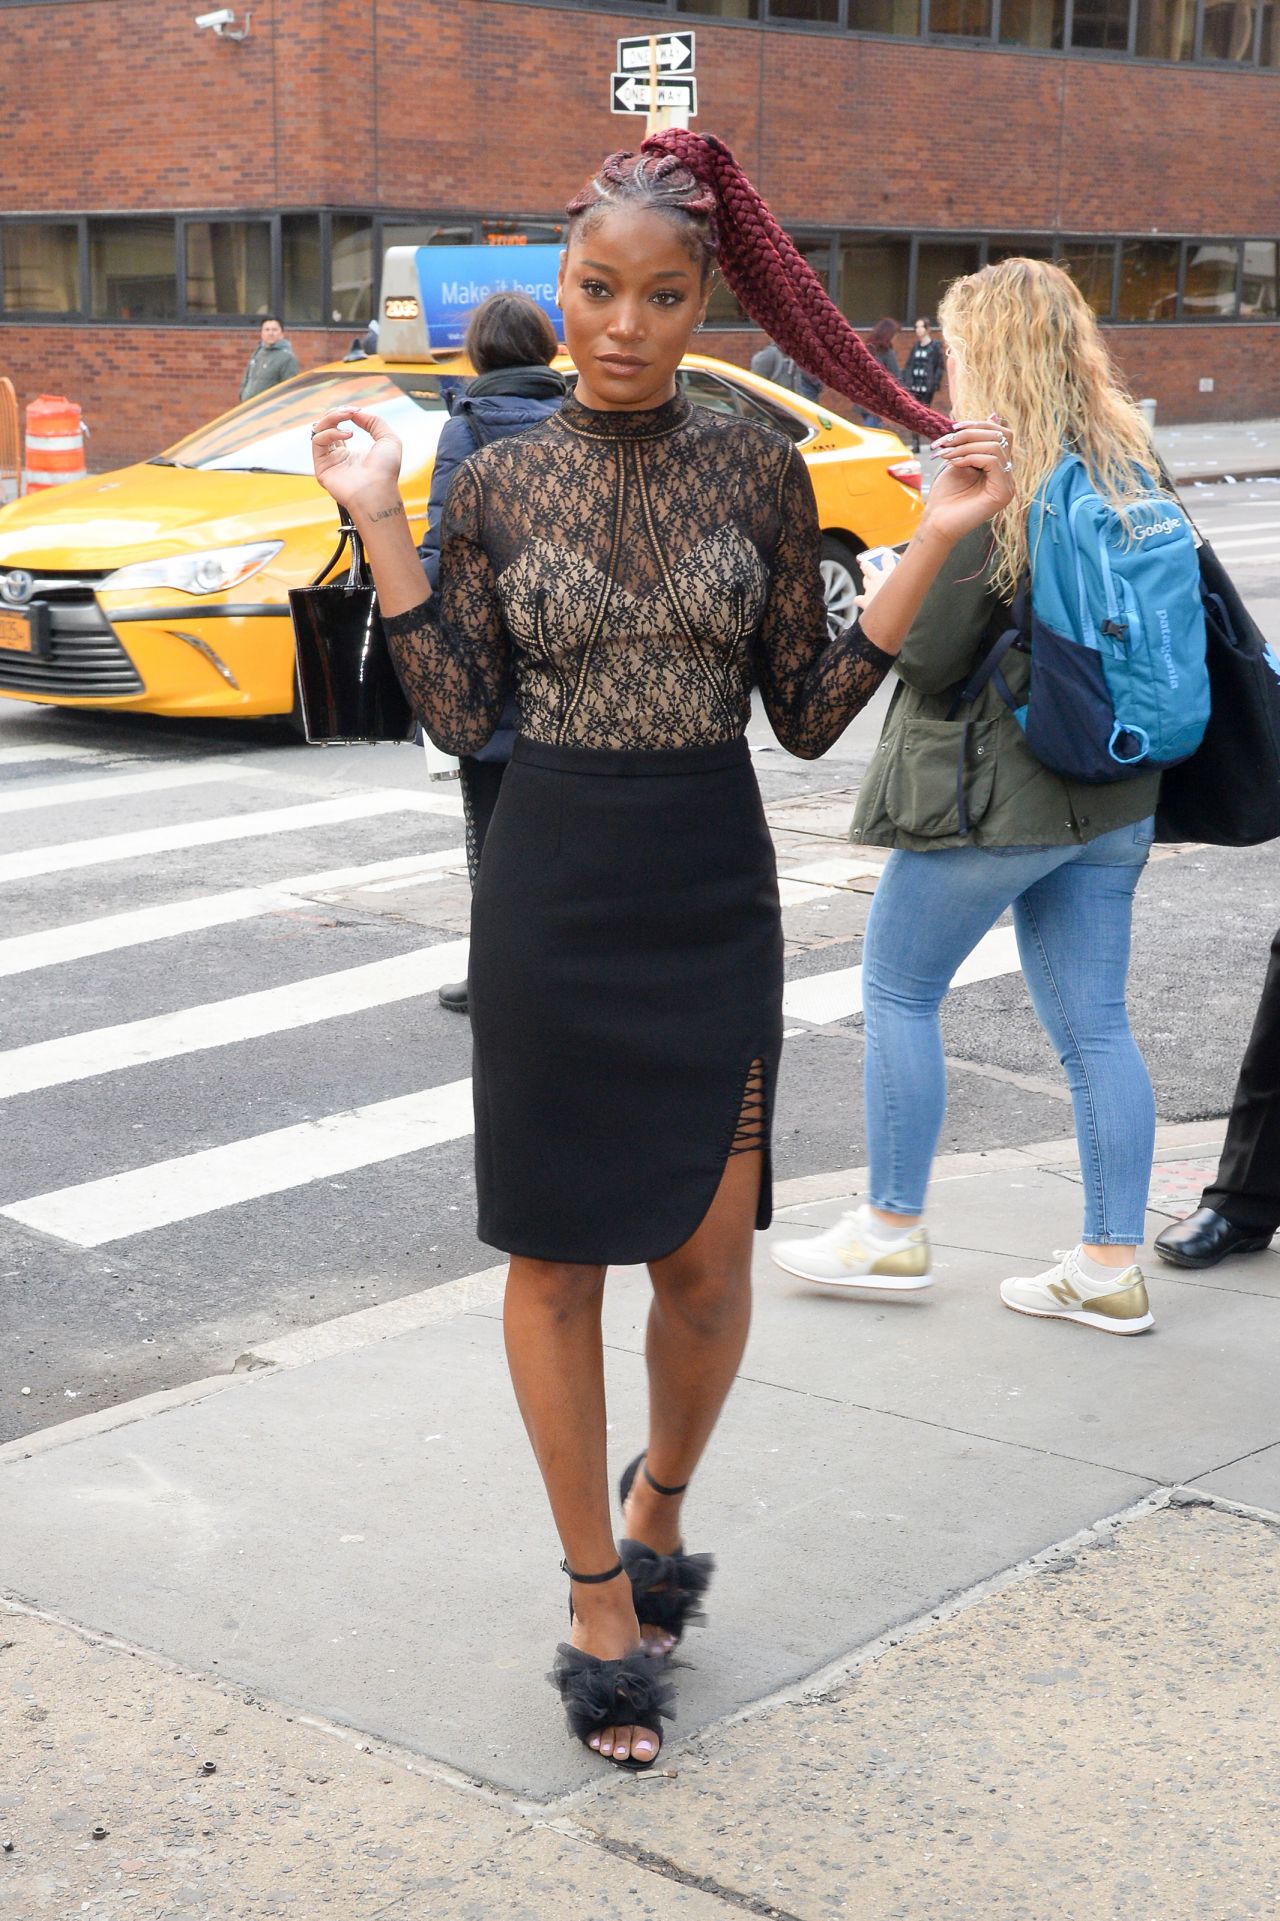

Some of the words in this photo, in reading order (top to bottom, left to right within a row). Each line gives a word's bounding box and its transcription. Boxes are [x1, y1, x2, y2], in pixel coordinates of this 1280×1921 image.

[628, 48, 650, 65] ONE
[659, 46, 682, 61] WAY
[624, 87, 647, 102] ONE
[657, 88, 683, 102] WAY
[441, 280, 490, 305] Make
[1134, 517, 1182, 540] Google
[1155, 609, 1179, 690] patagonia
[1047, 1279, 1082, 1306] N
